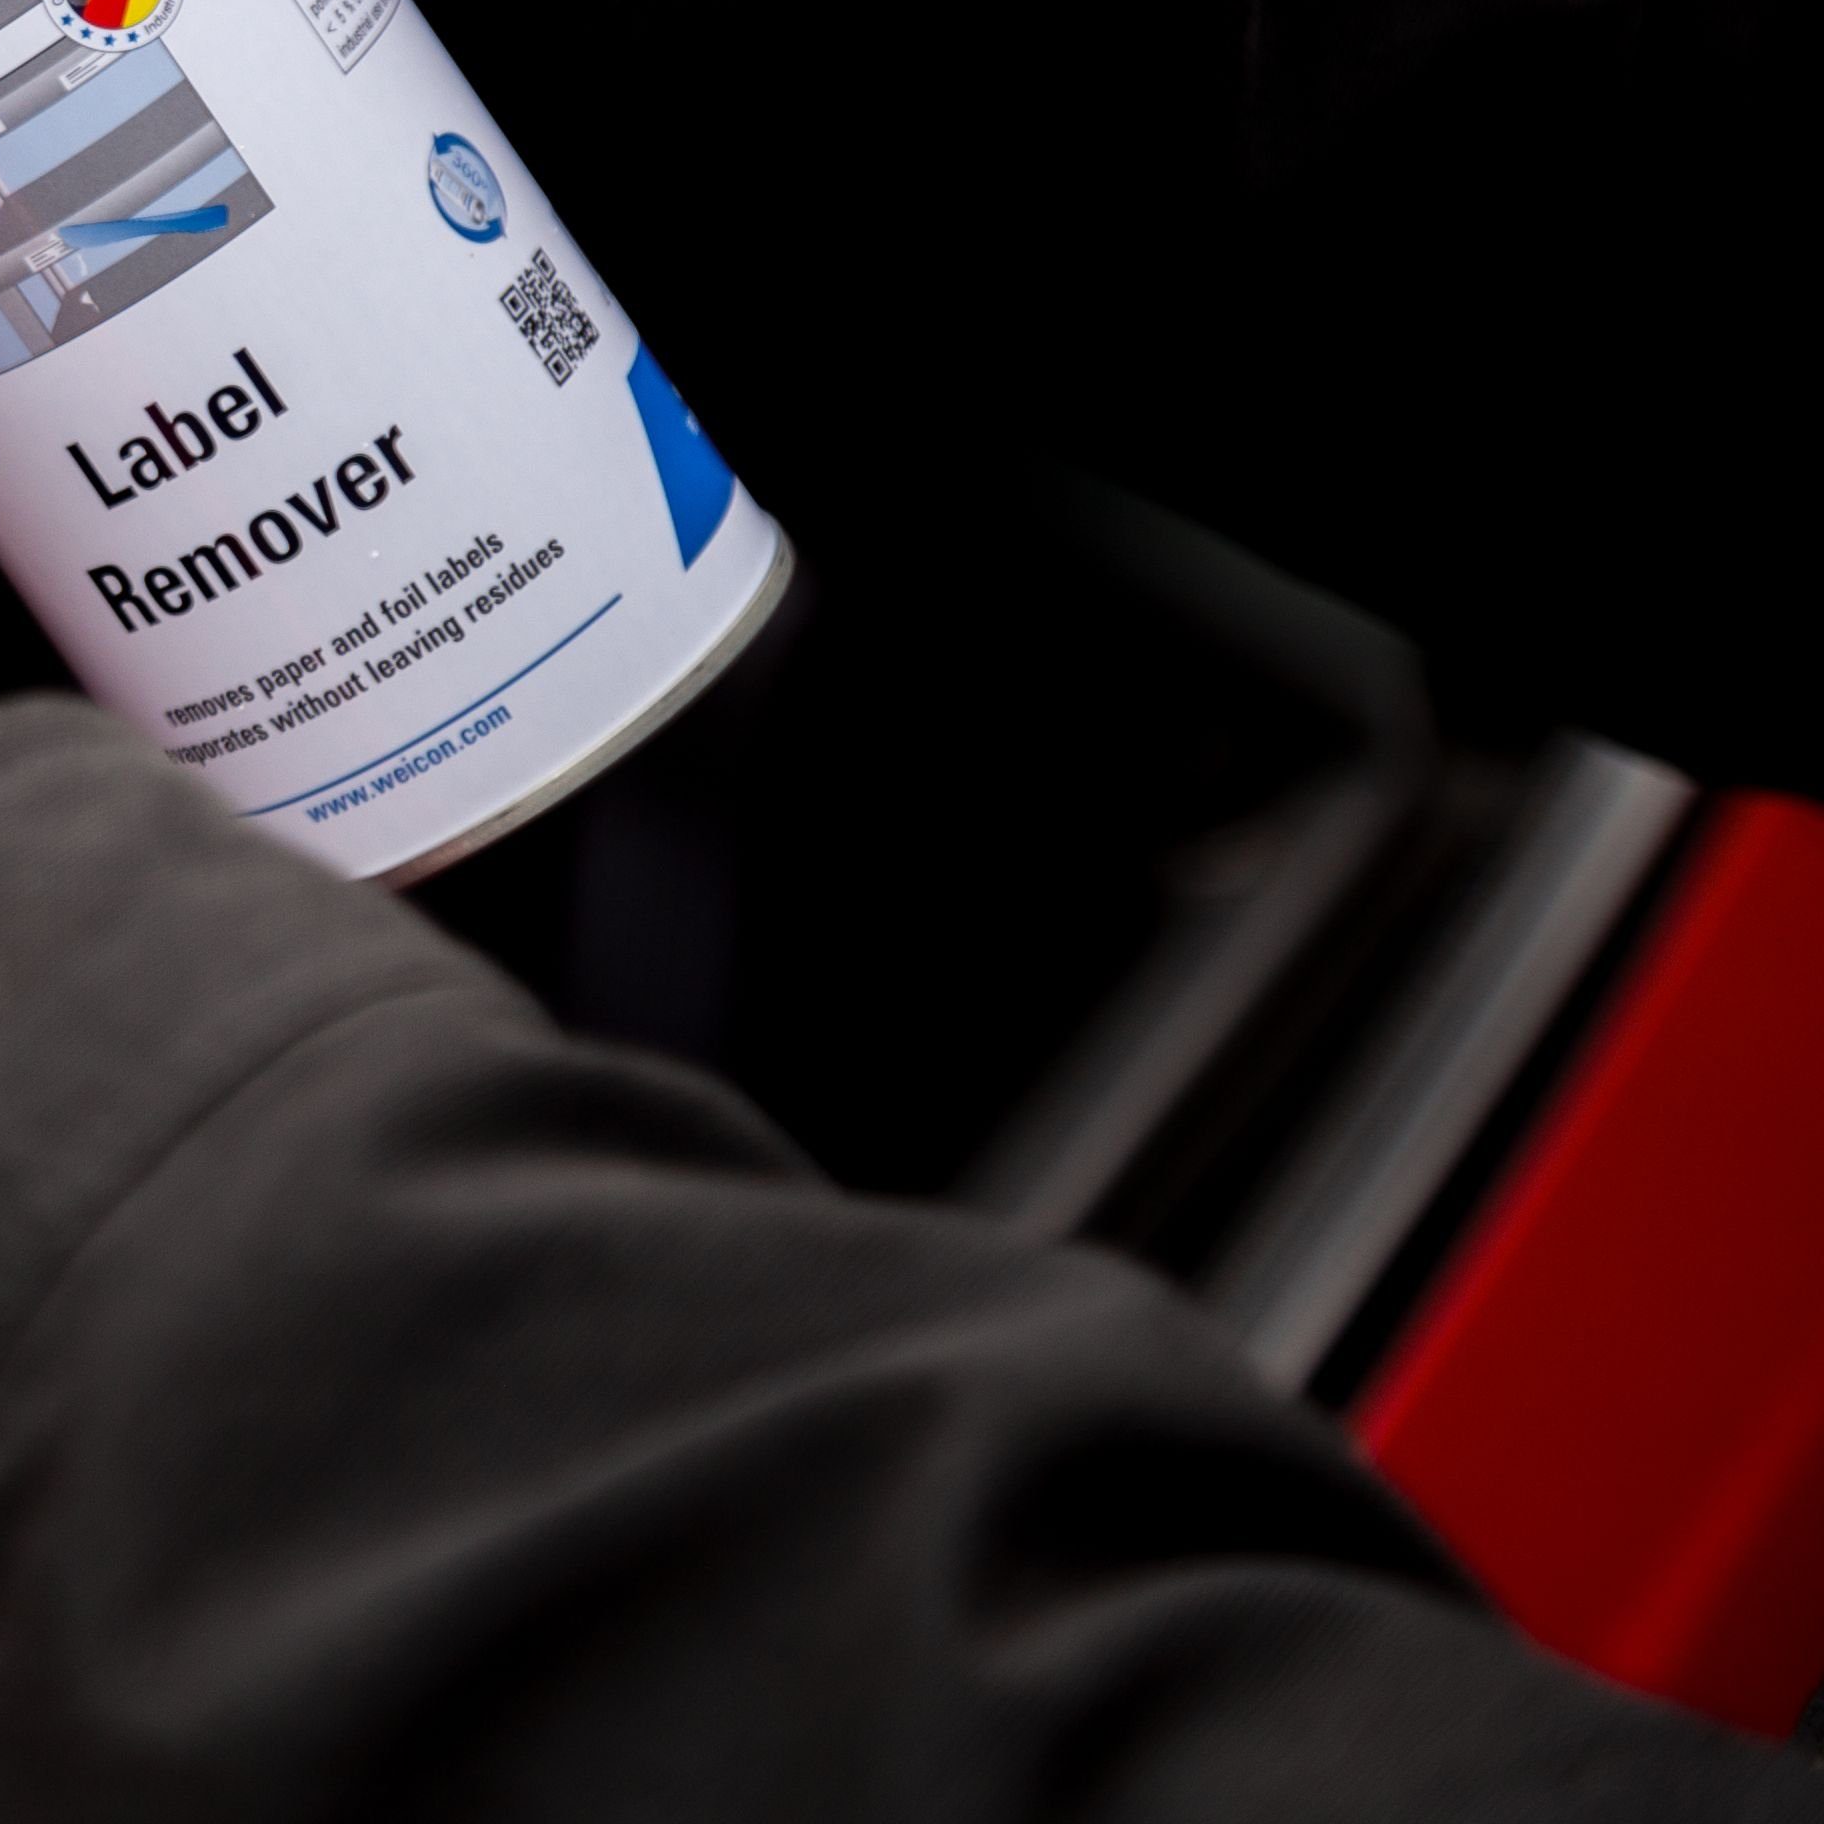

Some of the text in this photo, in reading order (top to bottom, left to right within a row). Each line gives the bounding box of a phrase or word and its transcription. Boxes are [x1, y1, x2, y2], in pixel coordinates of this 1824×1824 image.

[66, 346, 289, 510] Label
[86, 424, 417, 633] Remover
[165, 533, 505, 728] removes paper and foil labels
[269, 673, 369, 733] without
[364, 615, 466, 684] leaving
[462, 537, 565, 623] residues
[306, 704, 513, 824] www.weicon.com
